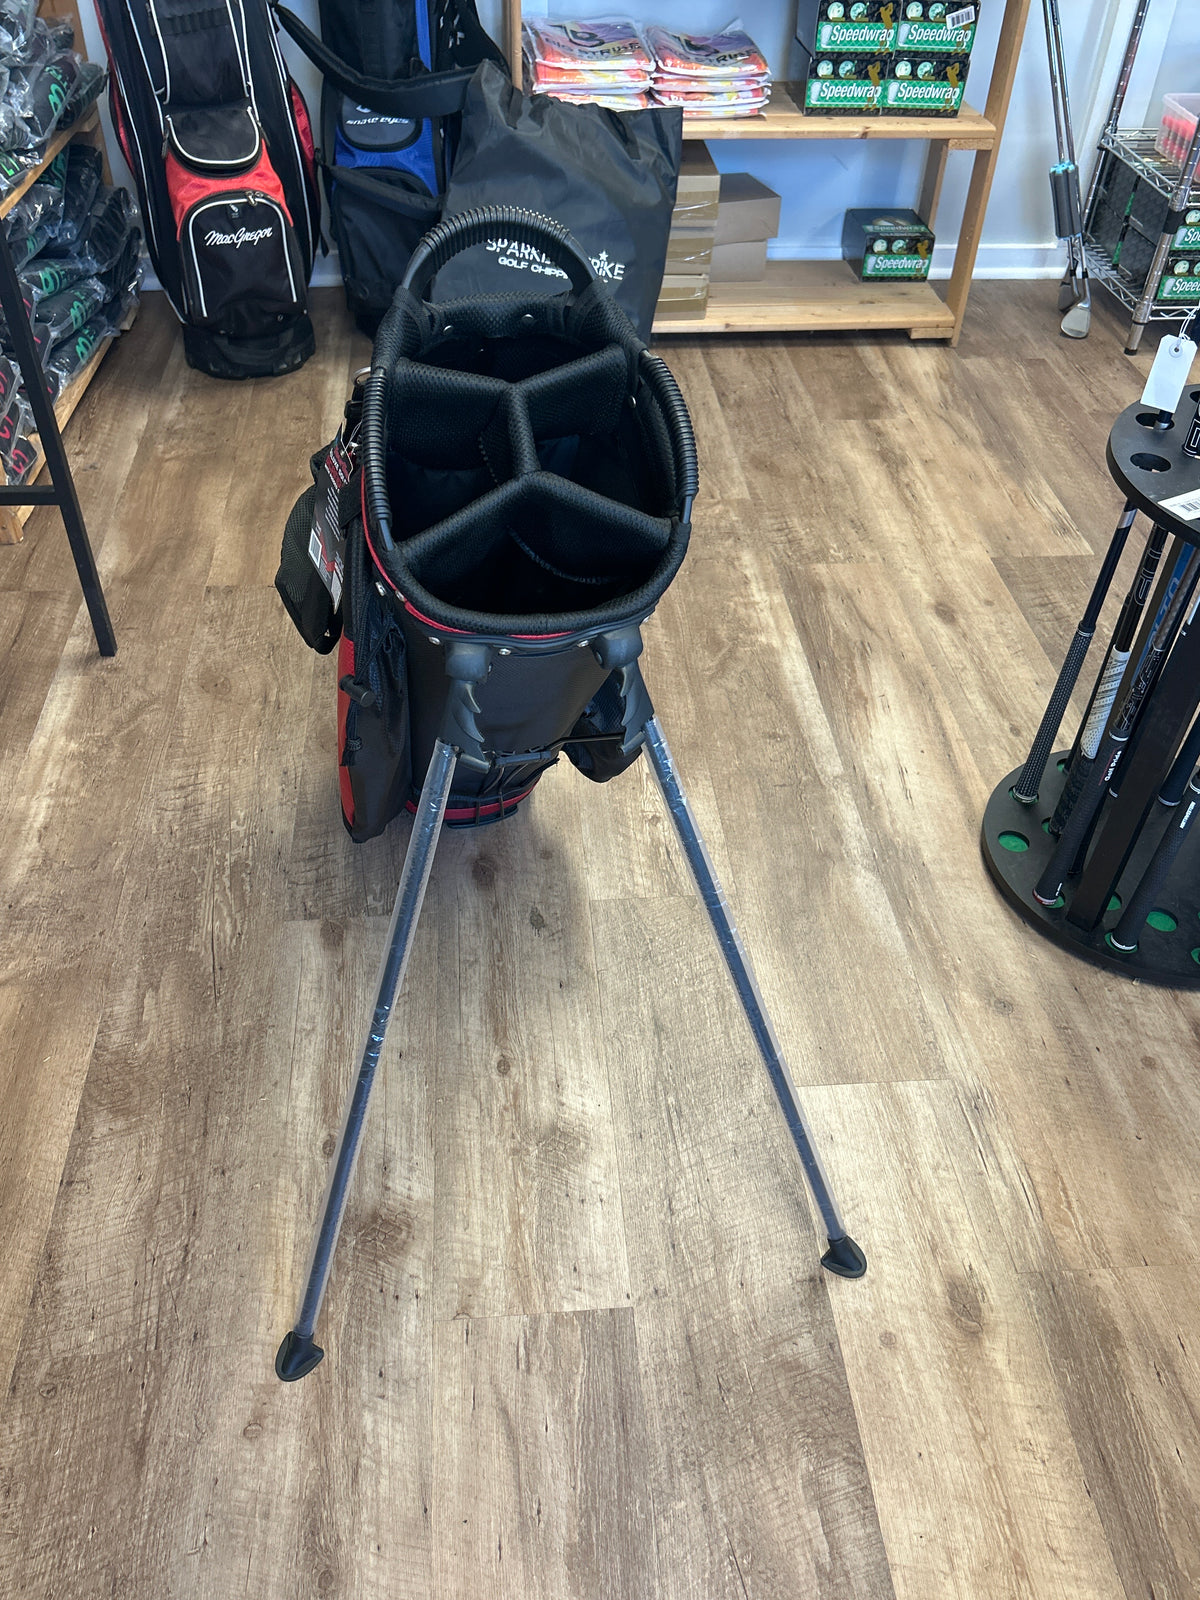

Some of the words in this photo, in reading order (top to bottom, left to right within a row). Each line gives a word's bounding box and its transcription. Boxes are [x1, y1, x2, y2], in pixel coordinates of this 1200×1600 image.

[830, 24, 895, 47] Speedwrap
[908, 24, 972, 47] Speedwrap
[820, 82, 882, 103] Speedwrap
[897, 82, 960, 104] Speedwrap
[204, 227, 273, 249] MacGregor
[498, 256, 529, 269] GOLF
